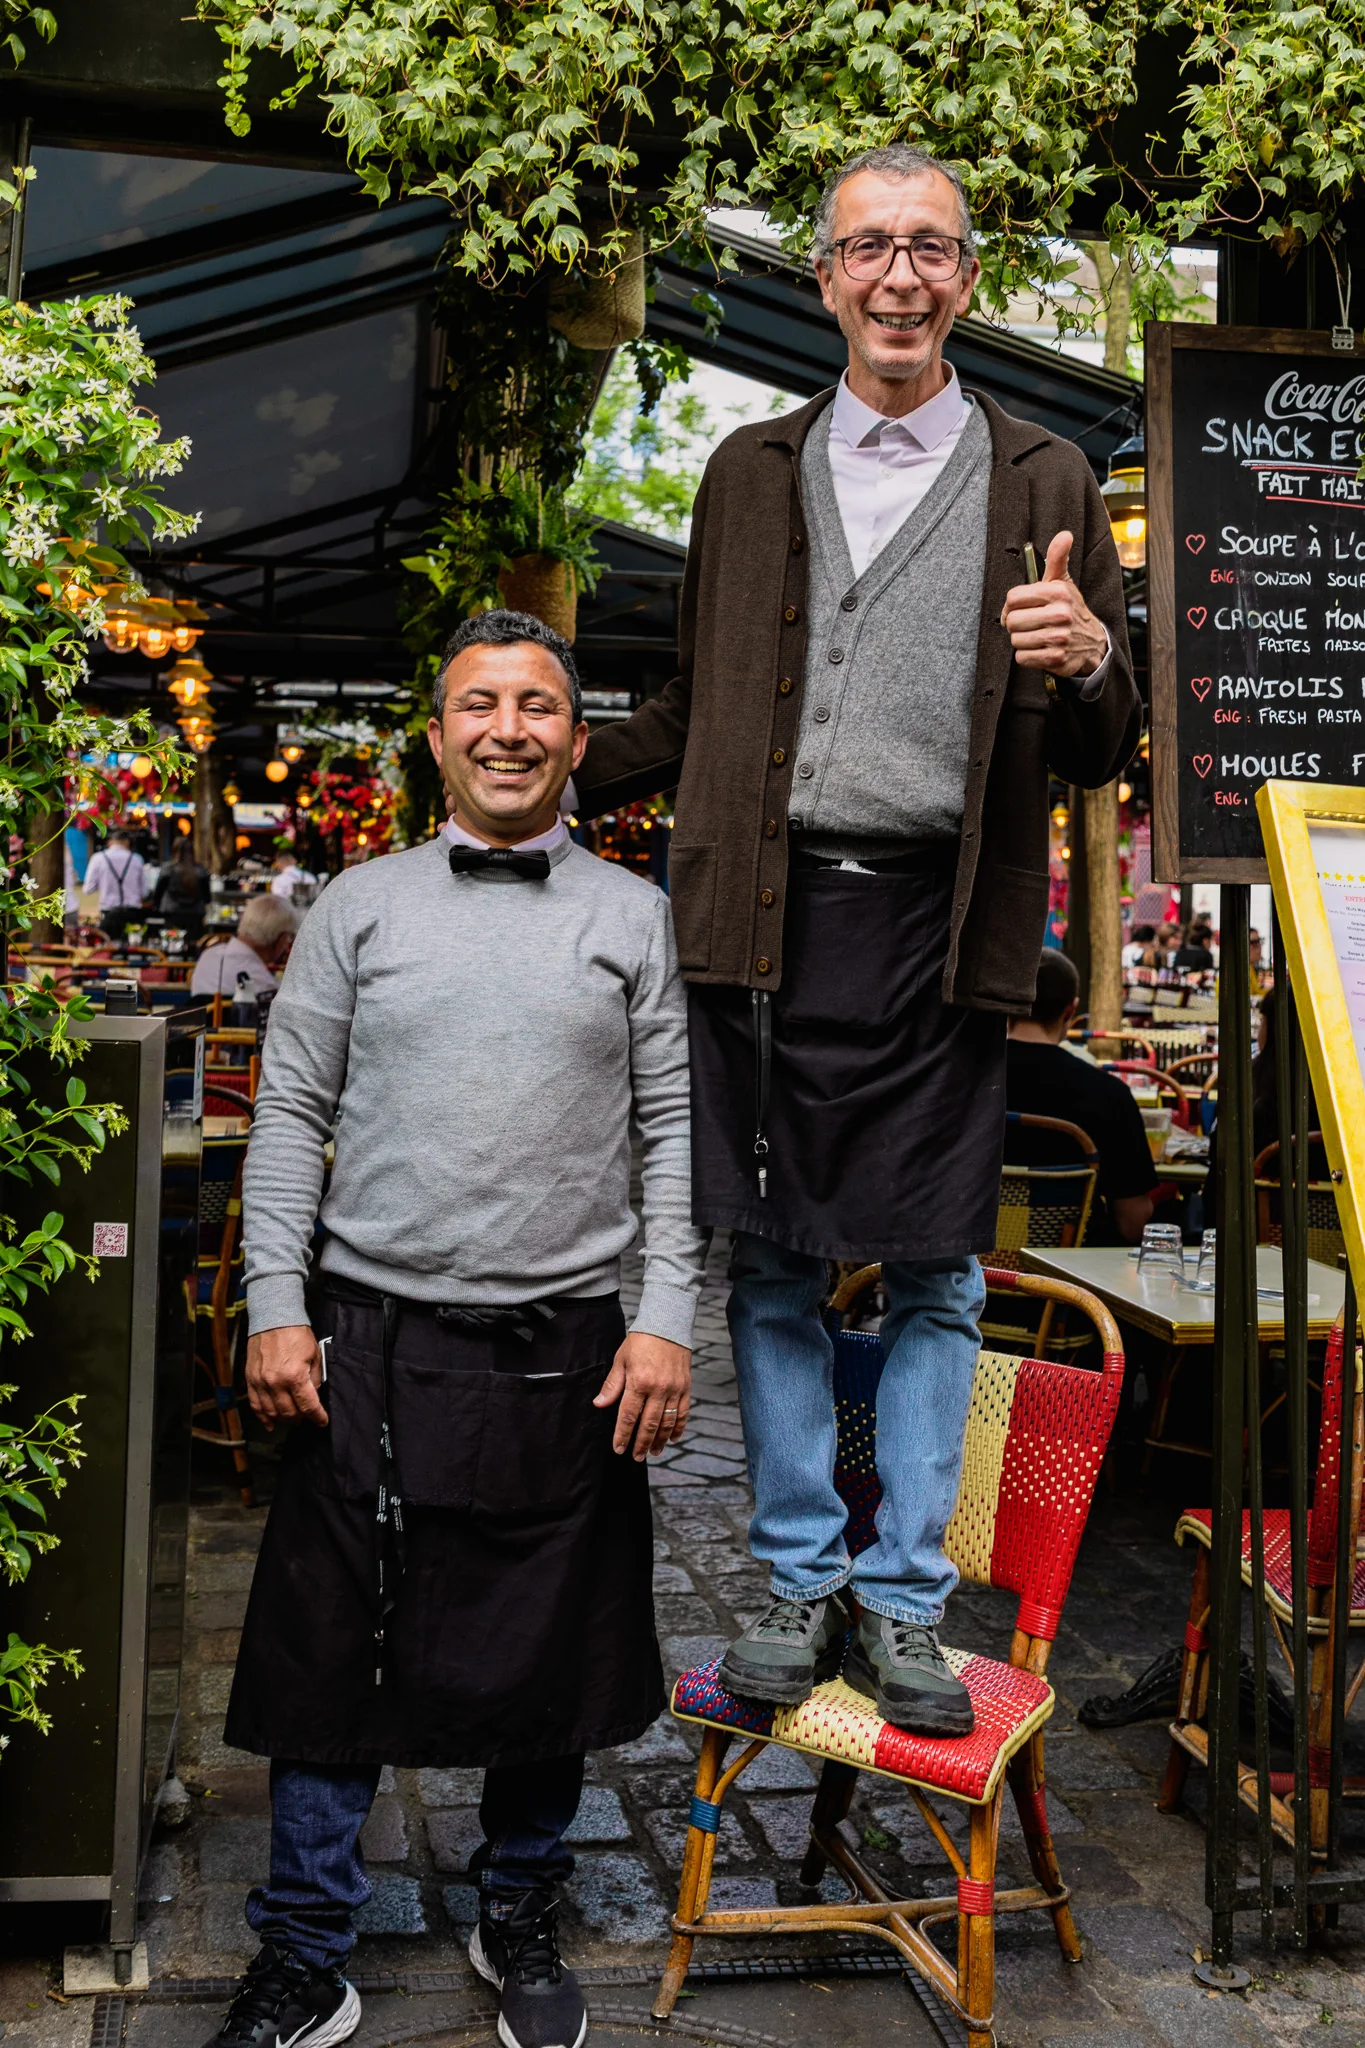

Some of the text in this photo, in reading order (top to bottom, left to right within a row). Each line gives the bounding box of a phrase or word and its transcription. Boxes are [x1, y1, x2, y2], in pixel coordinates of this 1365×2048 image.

[1202, 417, 1314, 459] SNACK
[1258, 471, 1365, 501] FAIT MAI
[1219, 525, 1297, 557] SOUPE
[1307, 524, 1321, 558] À
[1254, 571, 1312, 586] ONION
[1214, 607, 1308, 635] CROQUE
[1258, 636, 1311, 653] FRITES
[1218, 675, 1344, 700] RAVIOLIS
[1258, 706, 1307, 724] FRESH
[1317, 708, 1362, 724] PASTA
[1221, 751, 1322, 778] MOULES
